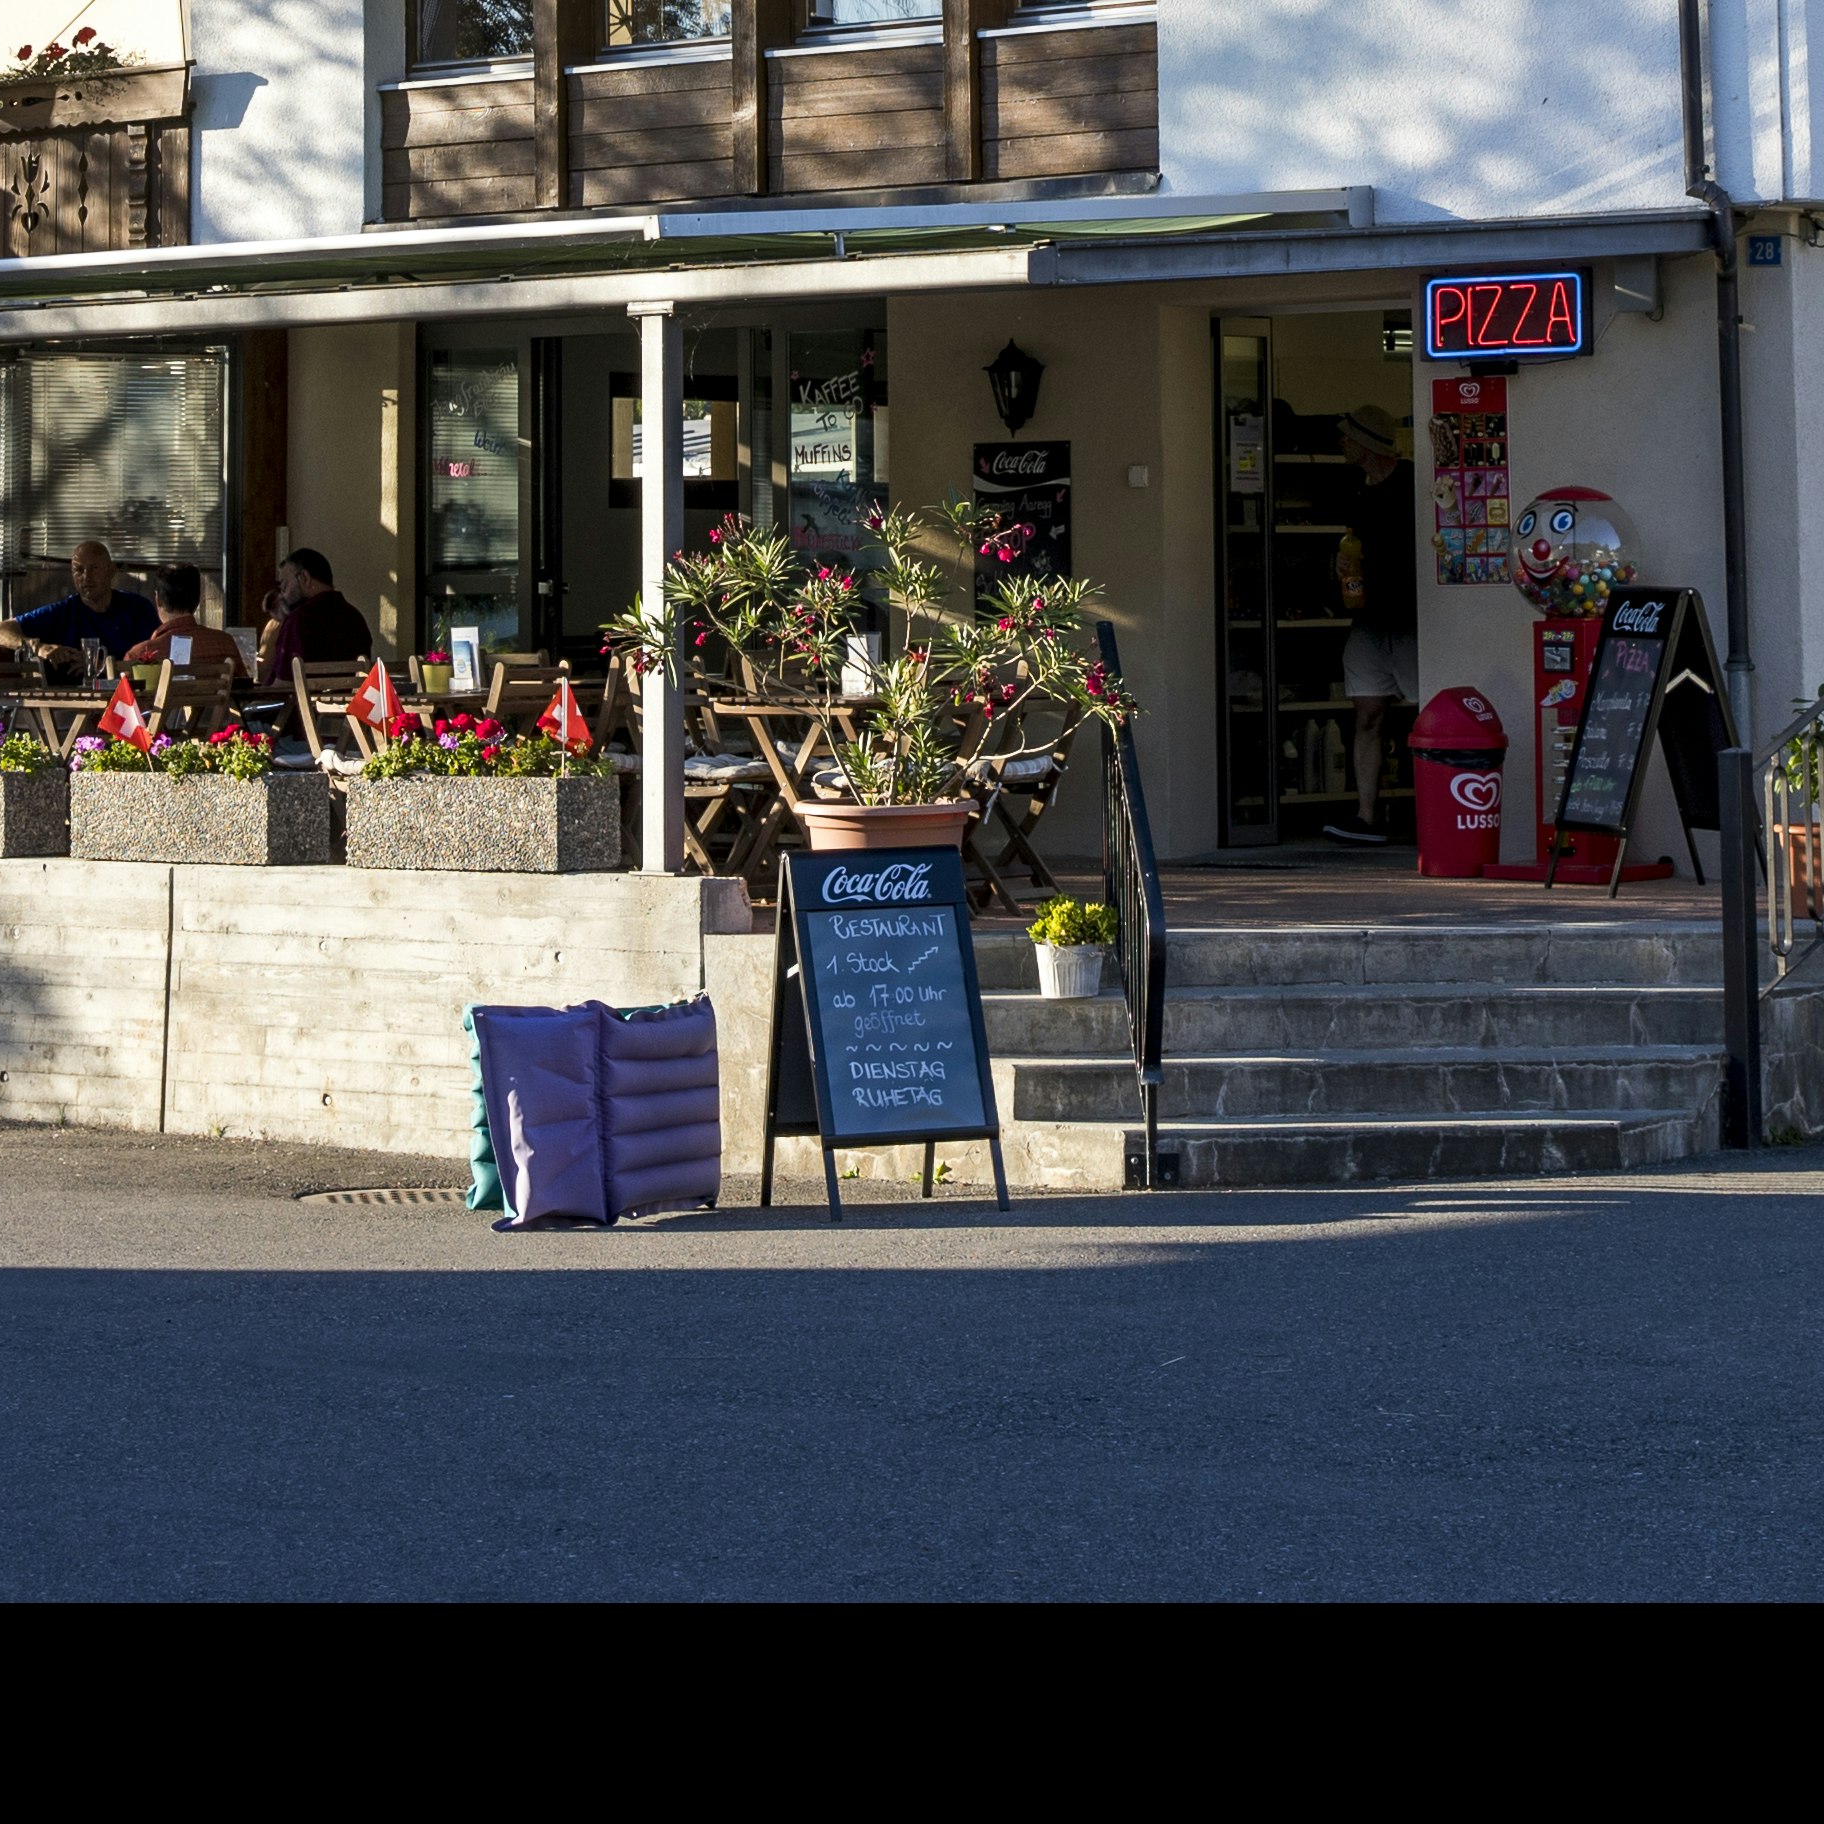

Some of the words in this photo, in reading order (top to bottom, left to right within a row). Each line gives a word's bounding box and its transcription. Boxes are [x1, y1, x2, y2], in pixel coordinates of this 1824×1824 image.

[1755, 241, 1775, 261] 28
[1434, 281, 1576, 348] PIZZA
[798, 371, 860, 407] KAFFEE
[816, 414, 837, 431] TO
[794, 444, 852, 465] MUFFINS
[1615, 639, 1650, 673] PIZZA
[1456, 814, 1500, 830] LUSSO
[822, 863, 934, 903] Coca-Cola
[828, 913, 947, 941] RESTAURANT
[826, 954, 845, 975] 1.
[846, 950, 900, 973] Stock
[832, 989, 856, 1008] ab
[918, 985, 947, 1002] Uhr
[854, 1009, 926, 1038] geöffnet
[850, 1059, 946, 1081] DIENSTAG
[851, 1085, 944, 1108] RUHETAG
